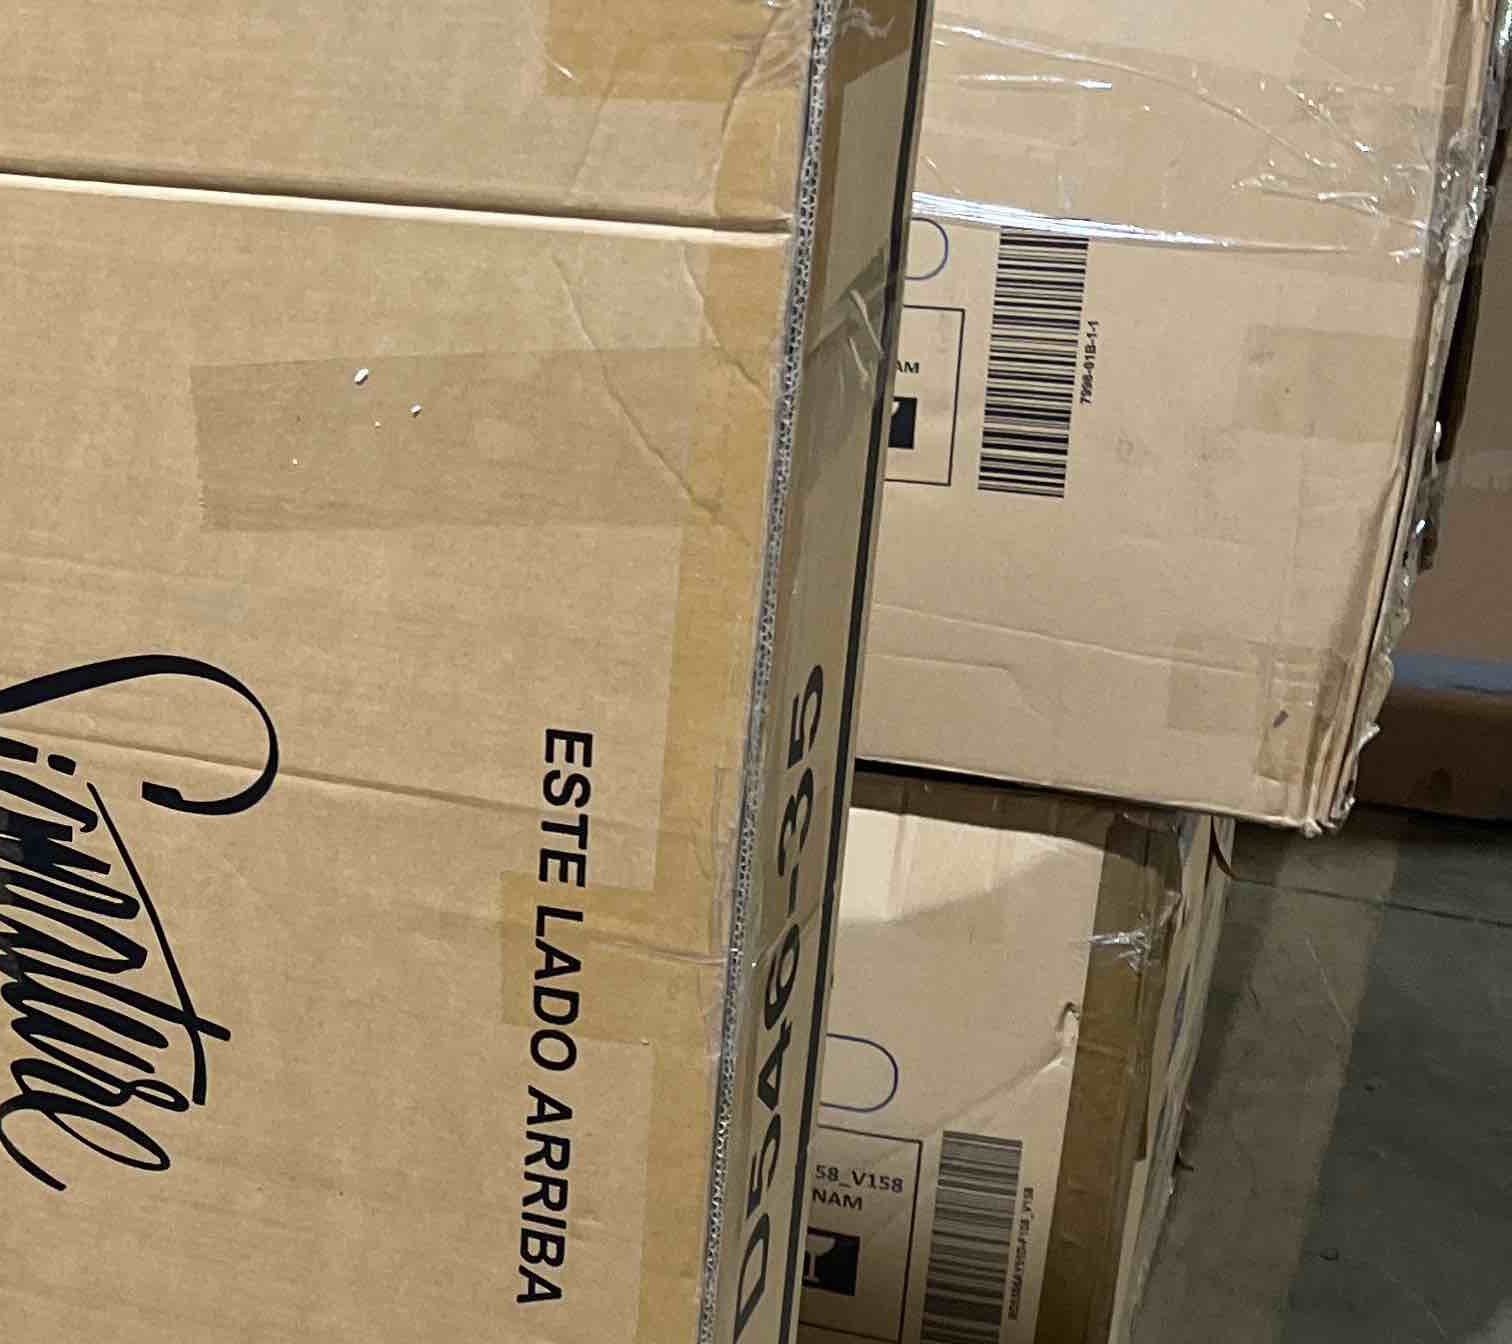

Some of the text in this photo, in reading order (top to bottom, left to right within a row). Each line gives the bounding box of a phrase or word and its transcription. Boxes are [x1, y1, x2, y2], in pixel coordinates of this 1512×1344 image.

[517, 729, 592, 1303] ESTE LADO ARRIBA
